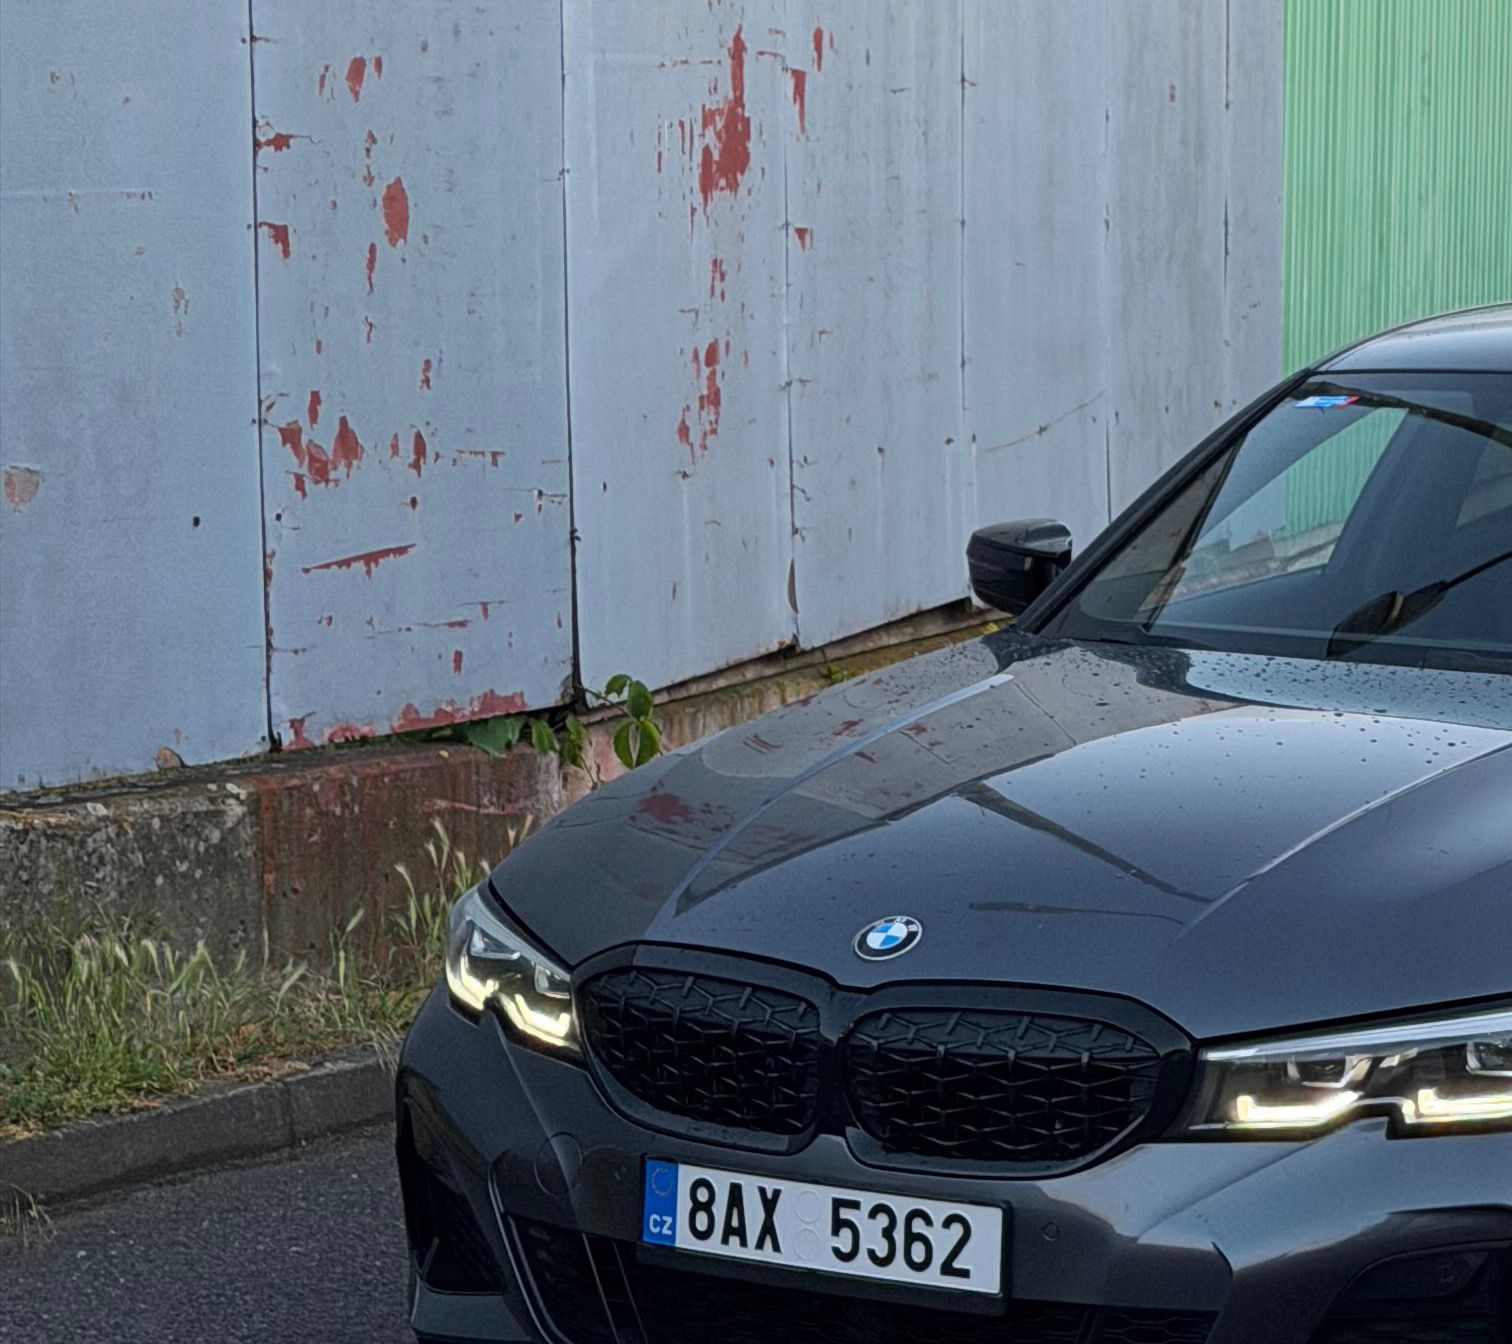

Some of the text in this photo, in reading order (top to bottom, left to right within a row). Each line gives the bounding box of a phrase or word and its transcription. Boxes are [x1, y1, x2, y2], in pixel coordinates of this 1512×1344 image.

[649, 1213, 673, 1236] CZ
[688, 1177, 973, 1279] 8AX 5362
